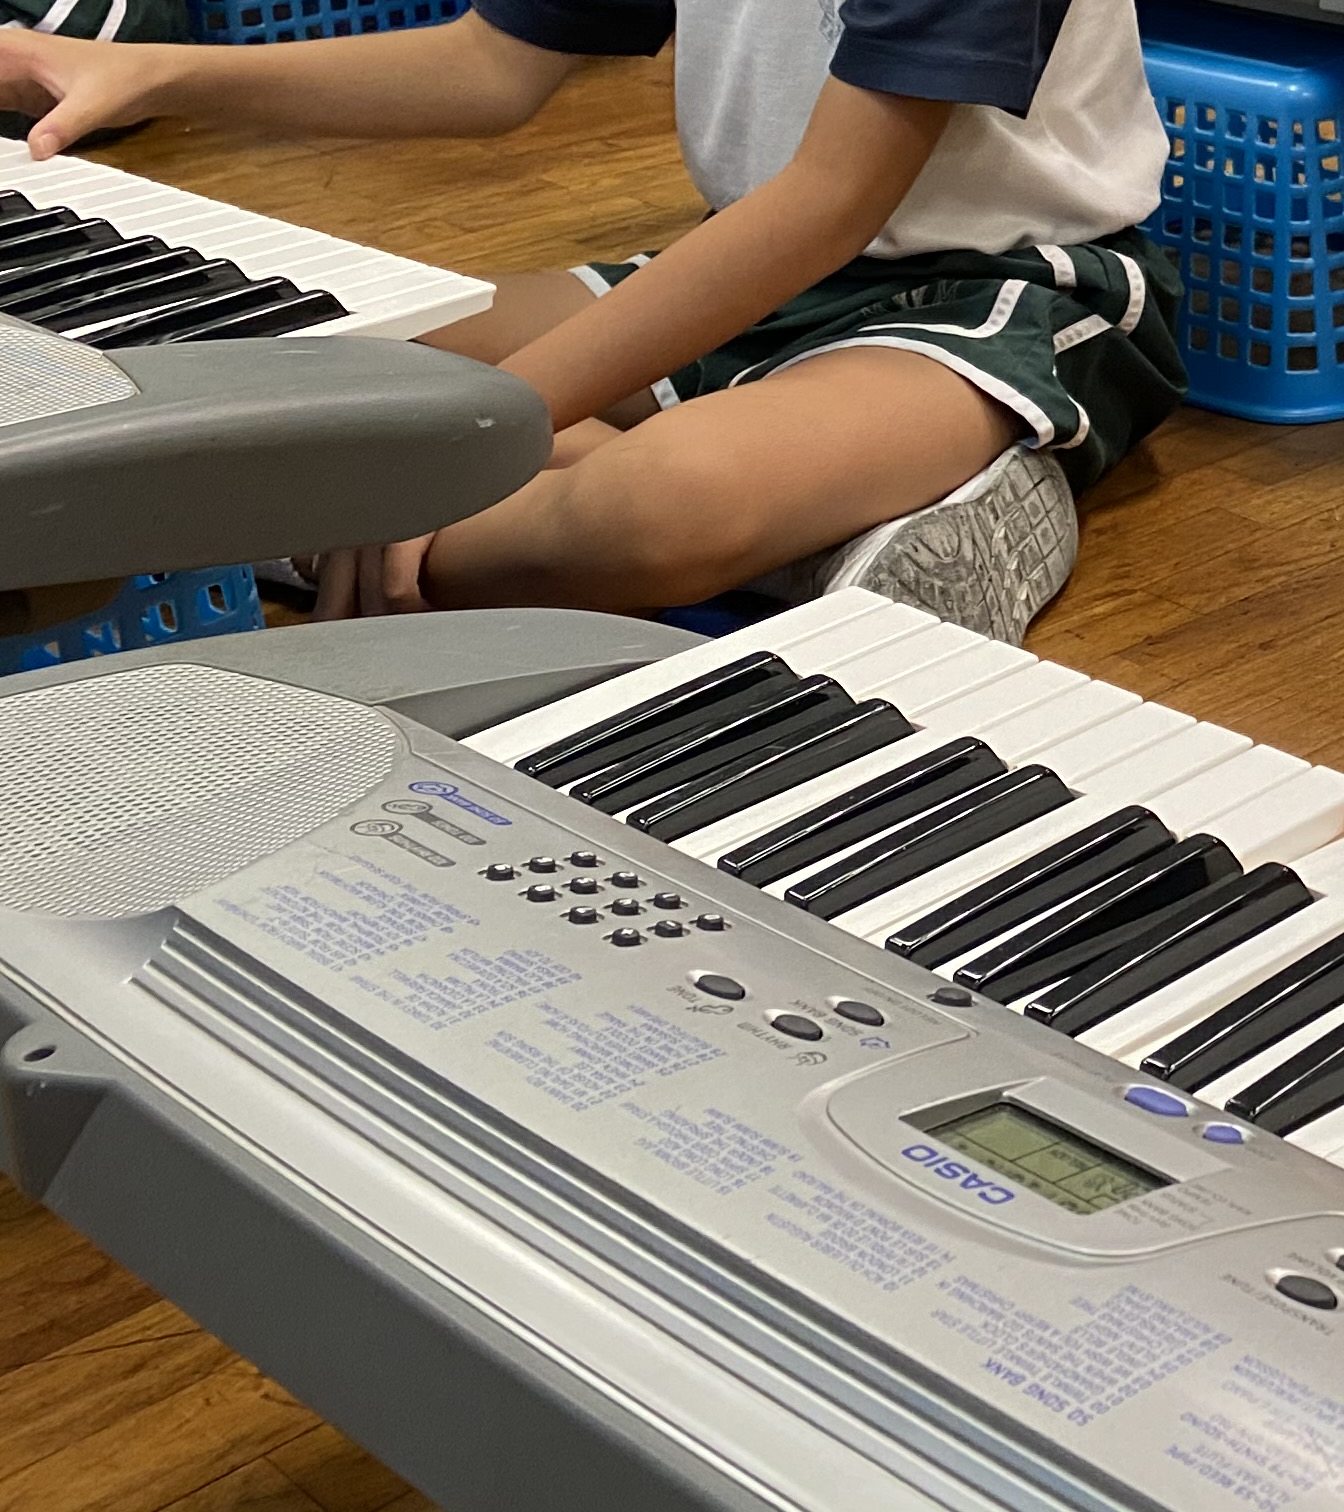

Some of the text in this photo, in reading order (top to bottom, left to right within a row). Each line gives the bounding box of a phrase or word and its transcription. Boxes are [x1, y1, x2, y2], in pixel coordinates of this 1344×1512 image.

[666, 985, 698, 1002] TONE
[737, 1022, 791, 1049] RHYTHM
[902, 1145, 1013, 1203] CASIO
[982, 1358, 1025, 1385] BANK
[1023, 1383, 1069, 1411] SONG
